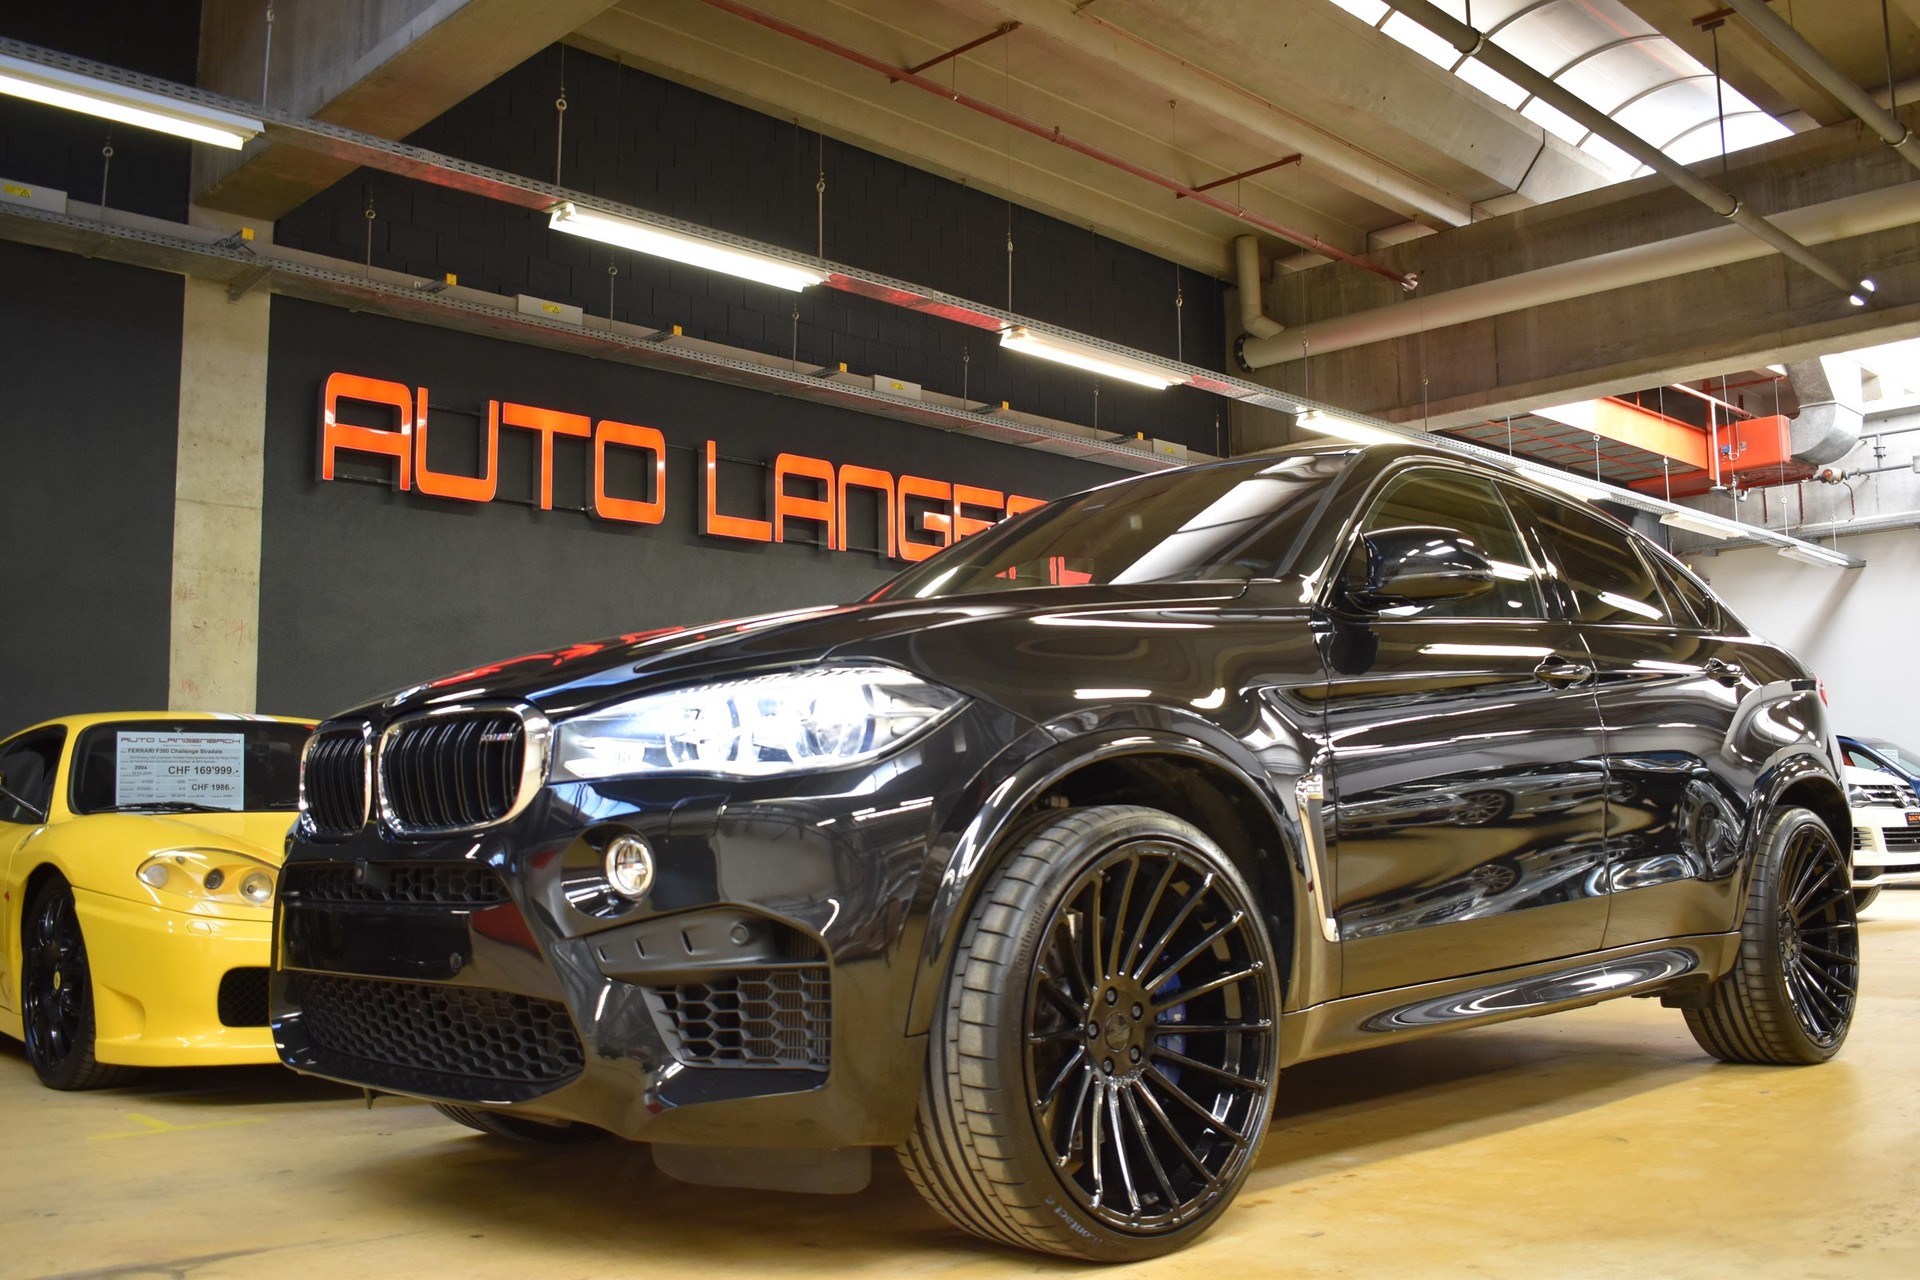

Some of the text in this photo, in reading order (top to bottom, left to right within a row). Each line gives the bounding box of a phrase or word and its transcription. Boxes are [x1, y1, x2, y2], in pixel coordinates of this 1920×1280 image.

[322, 371, 1050, 562] AUTO LANGE
[168, 765, 239, 775] CHF 169'999.-
[191, 783, 209, 791] CHF
[211, 783, 235, 791] 1986.-
